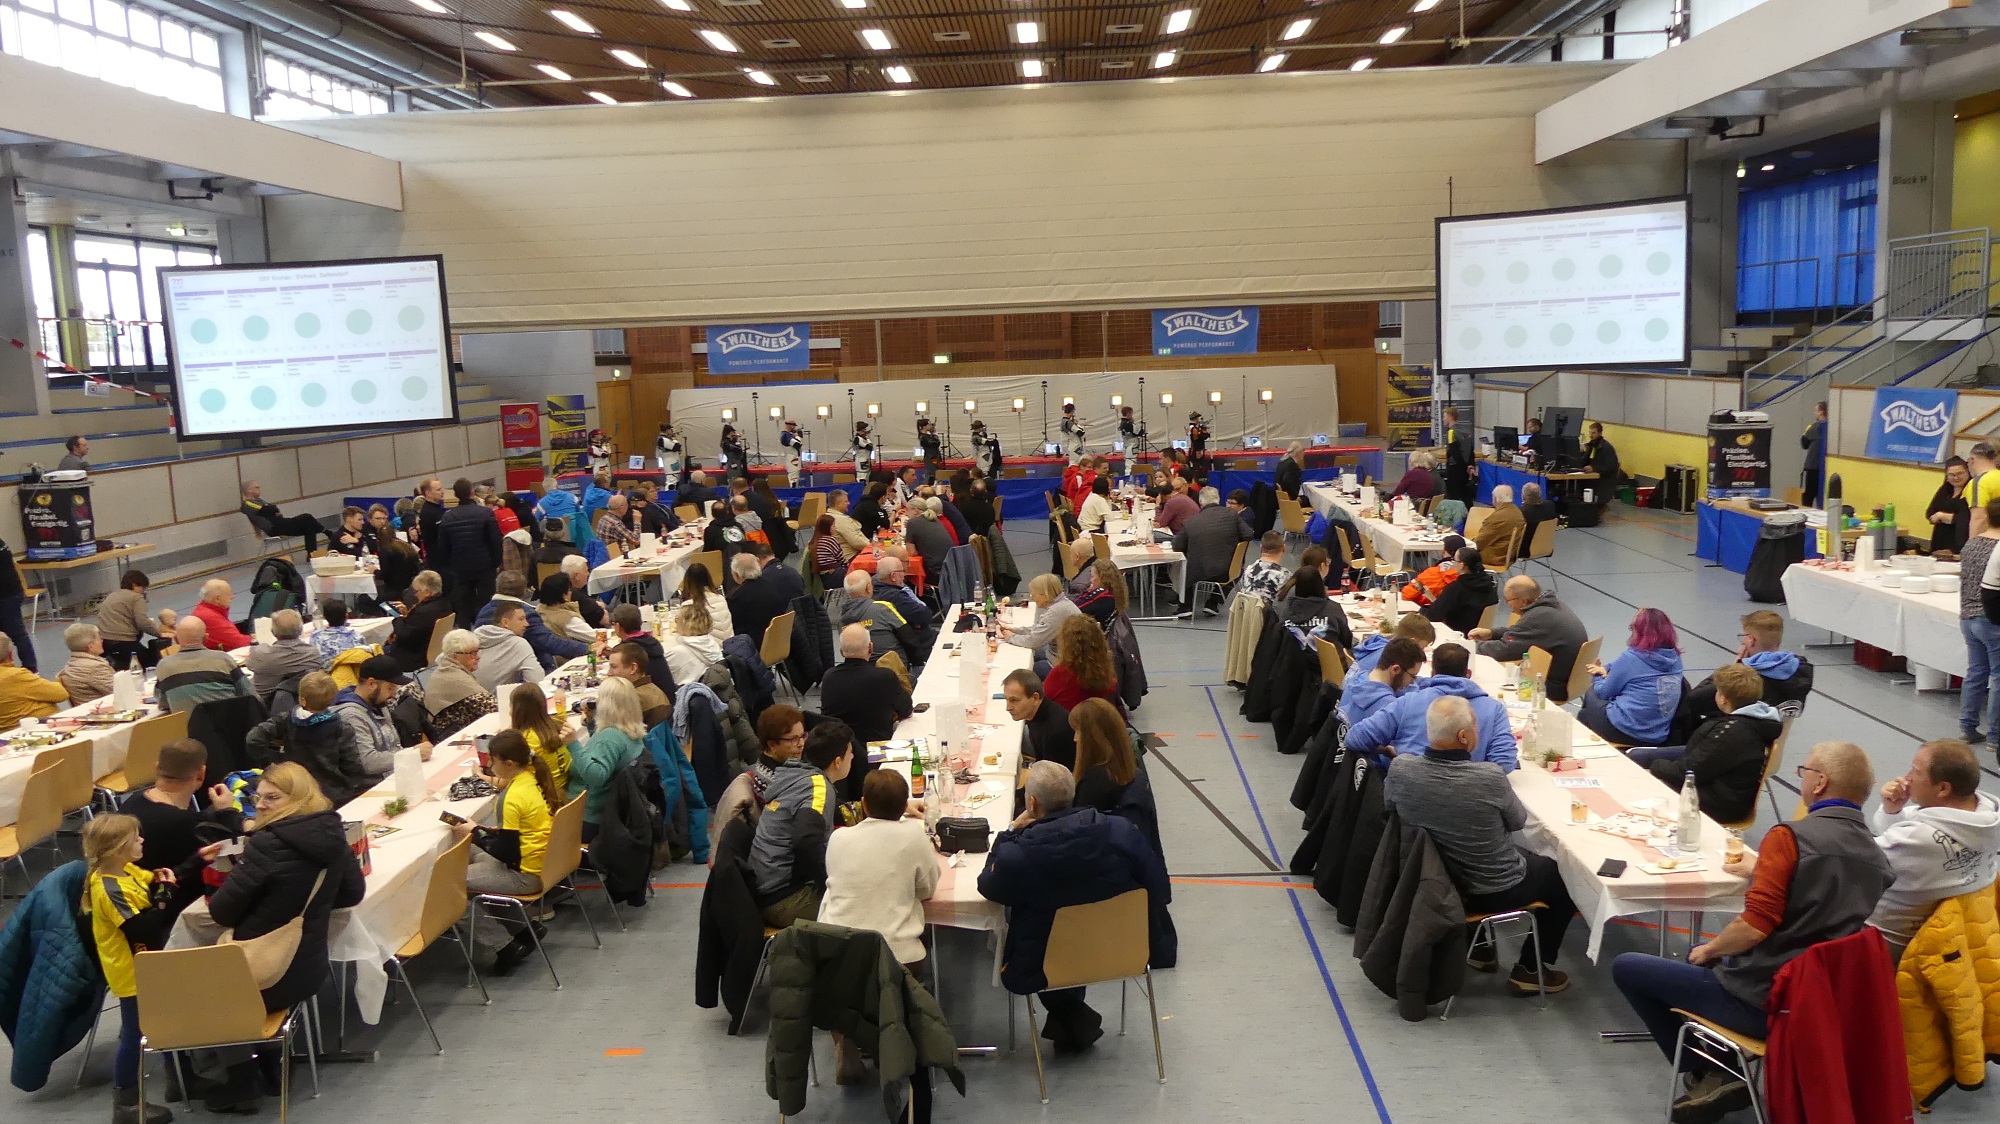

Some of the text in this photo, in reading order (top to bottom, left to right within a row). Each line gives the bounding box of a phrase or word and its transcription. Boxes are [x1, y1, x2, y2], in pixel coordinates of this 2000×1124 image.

[1892, 175, 1927, 185] Block H
[1173, 316, 1234, 331] WALTHER
[728, 333, 788, 348] WALTHER
[1890, 406, 1939, 431] WALTHER
